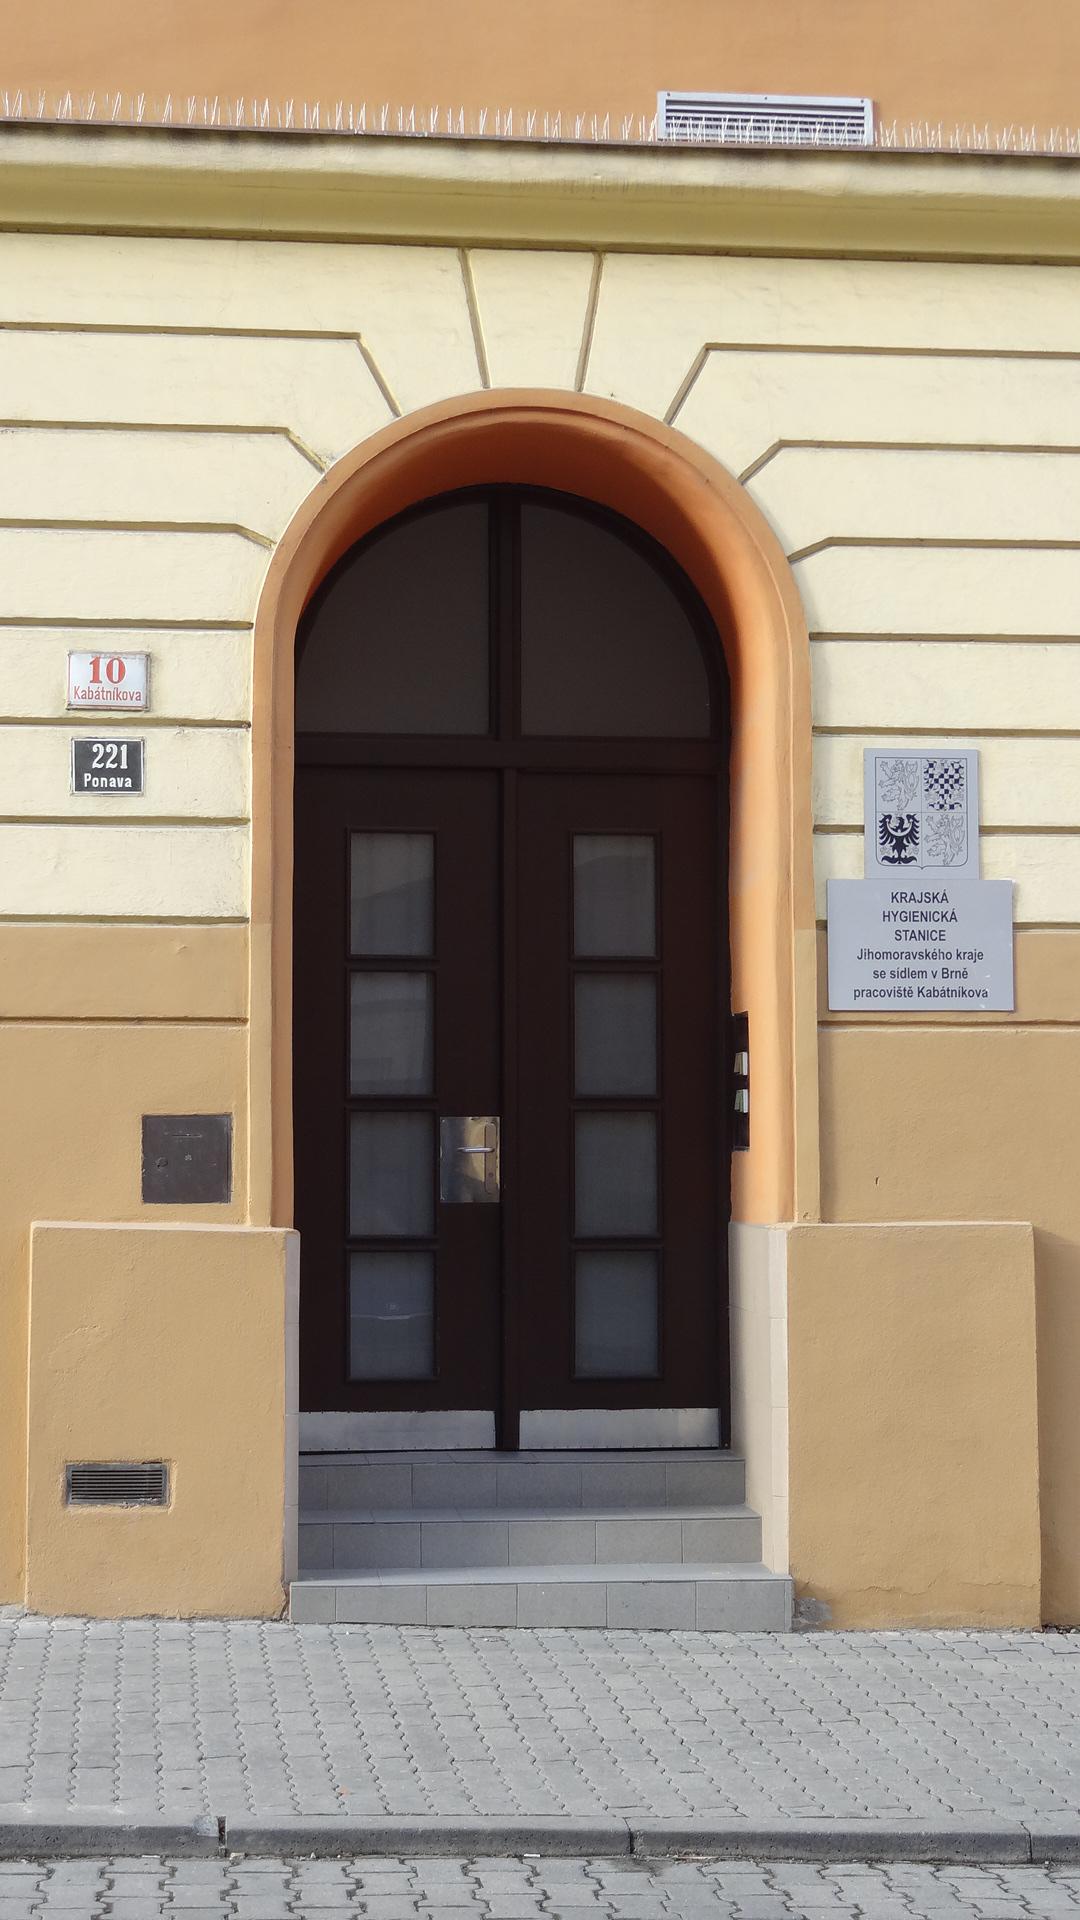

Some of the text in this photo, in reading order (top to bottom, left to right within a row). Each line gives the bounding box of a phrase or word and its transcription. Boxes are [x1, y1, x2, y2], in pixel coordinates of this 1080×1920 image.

[89, 655, 126, 684] 10
[73, 686, 142, 701] Kabátníkova
[92, 743, 128, 769] 221
[84, 772, 132, 788] Ponava
[890, 889, 949, 904] KRAJSKÁ
[882, 908, 958, 923] HYGIENICKÁ
[894, 929, 946, 942] STANICE
[856, 948, 984, 963] Jihomoravského kraje
[872, 967, 969, 980] se sídlem v Brně
[853, 986, 989, 1001] pracoviště Kabátníkova
